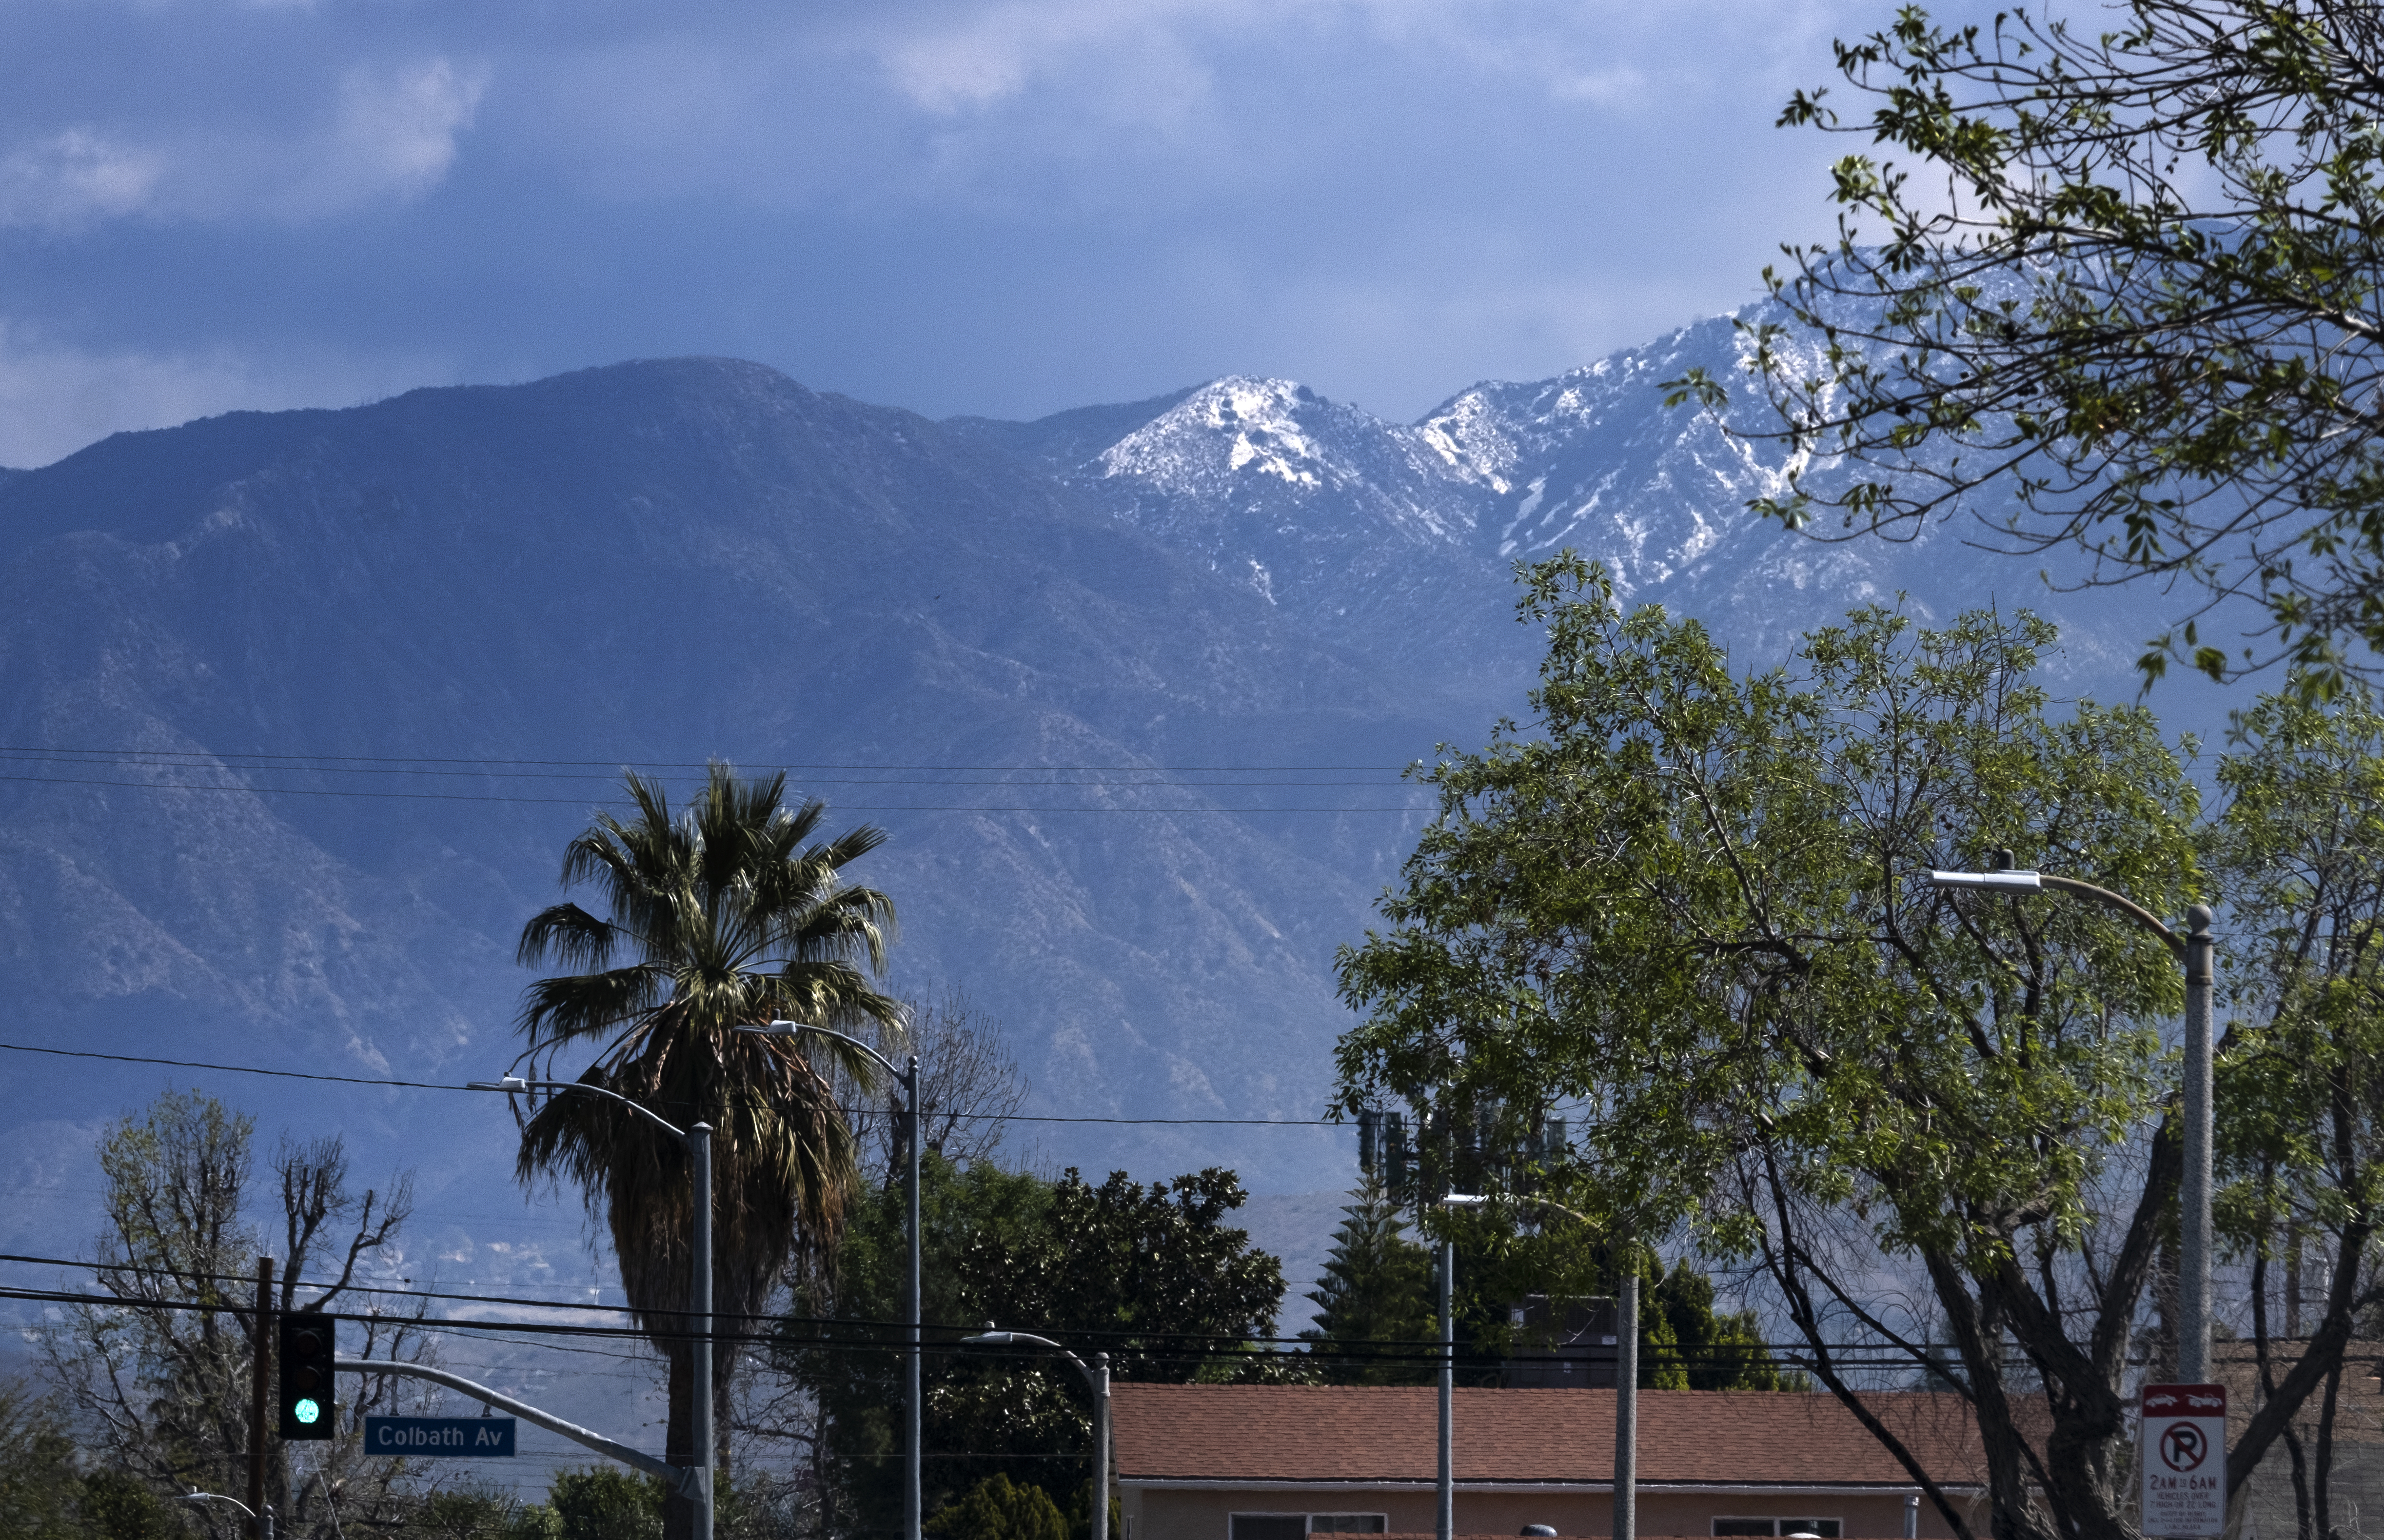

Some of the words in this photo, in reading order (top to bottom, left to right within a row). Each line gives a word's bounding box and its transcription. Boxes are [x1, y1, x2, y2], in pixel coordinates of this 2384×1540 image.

[378, 1425, 464, 1445] Colbath
[475, 1426, 502, 1446] Av
[2150, 1474, 2176, 1490] 2AM
[2189, 1474, 2216, 1490] 6AM
